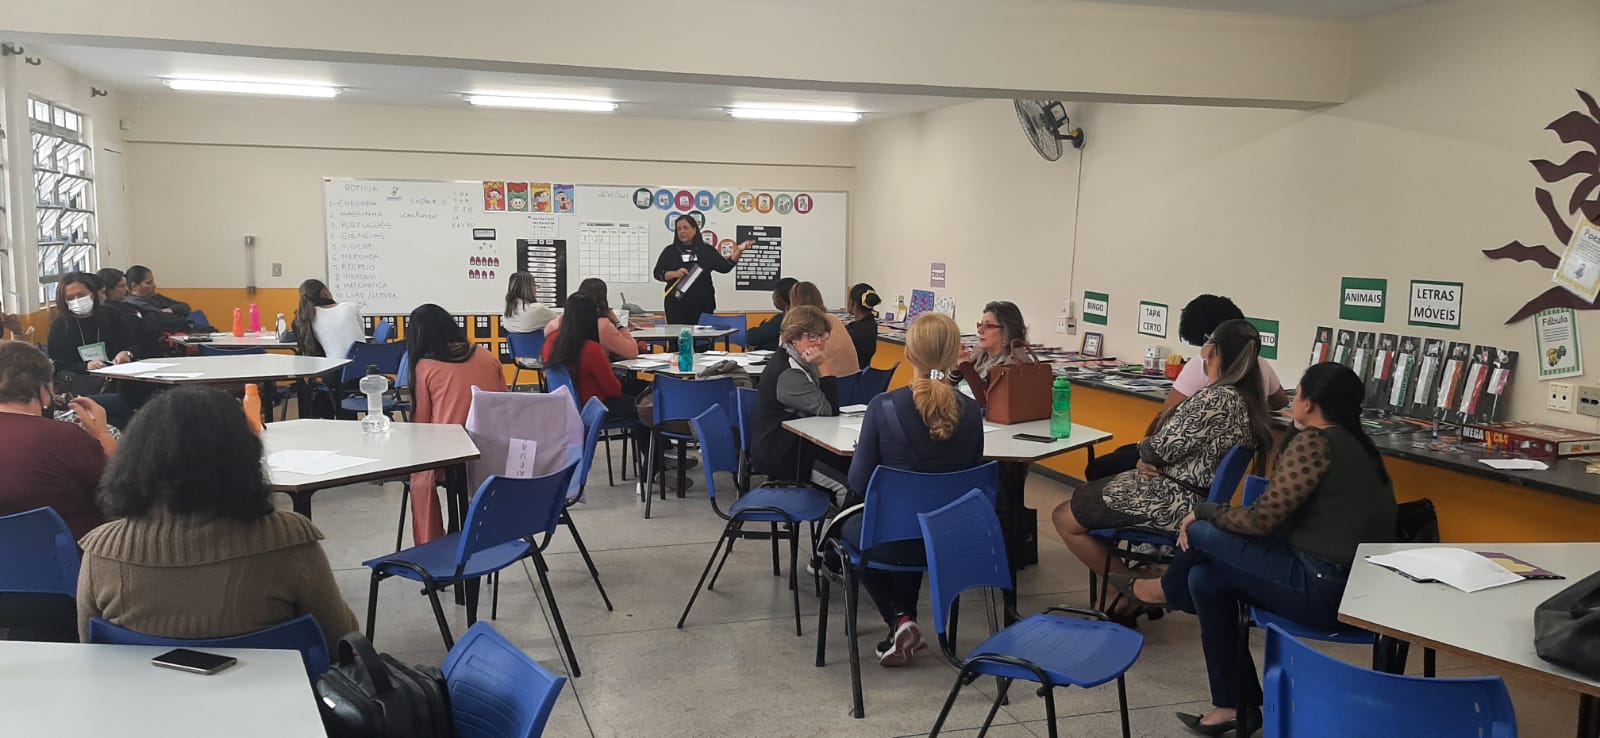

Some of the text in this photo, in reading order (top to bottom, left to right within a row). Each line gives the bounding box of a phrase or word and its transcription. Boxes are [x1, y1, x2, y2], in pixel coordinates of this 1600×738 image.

[341, 263, 375, 271] RECREIO
[1344, 292, 1382, 304] ANIMAIS
[1417, 288, 1455, 302] LETRAS
[1087, 301, 1104, 312] BINGO
[1145, 308, 1161, 318] TAPA
[1414, 305, 1456, 321] MÓVEIS
[1542, 315, 1568, 326] Fábula
[1142, 321, 1162, 332] CERTO
[1463, 427, 1484, 440] MEGA
